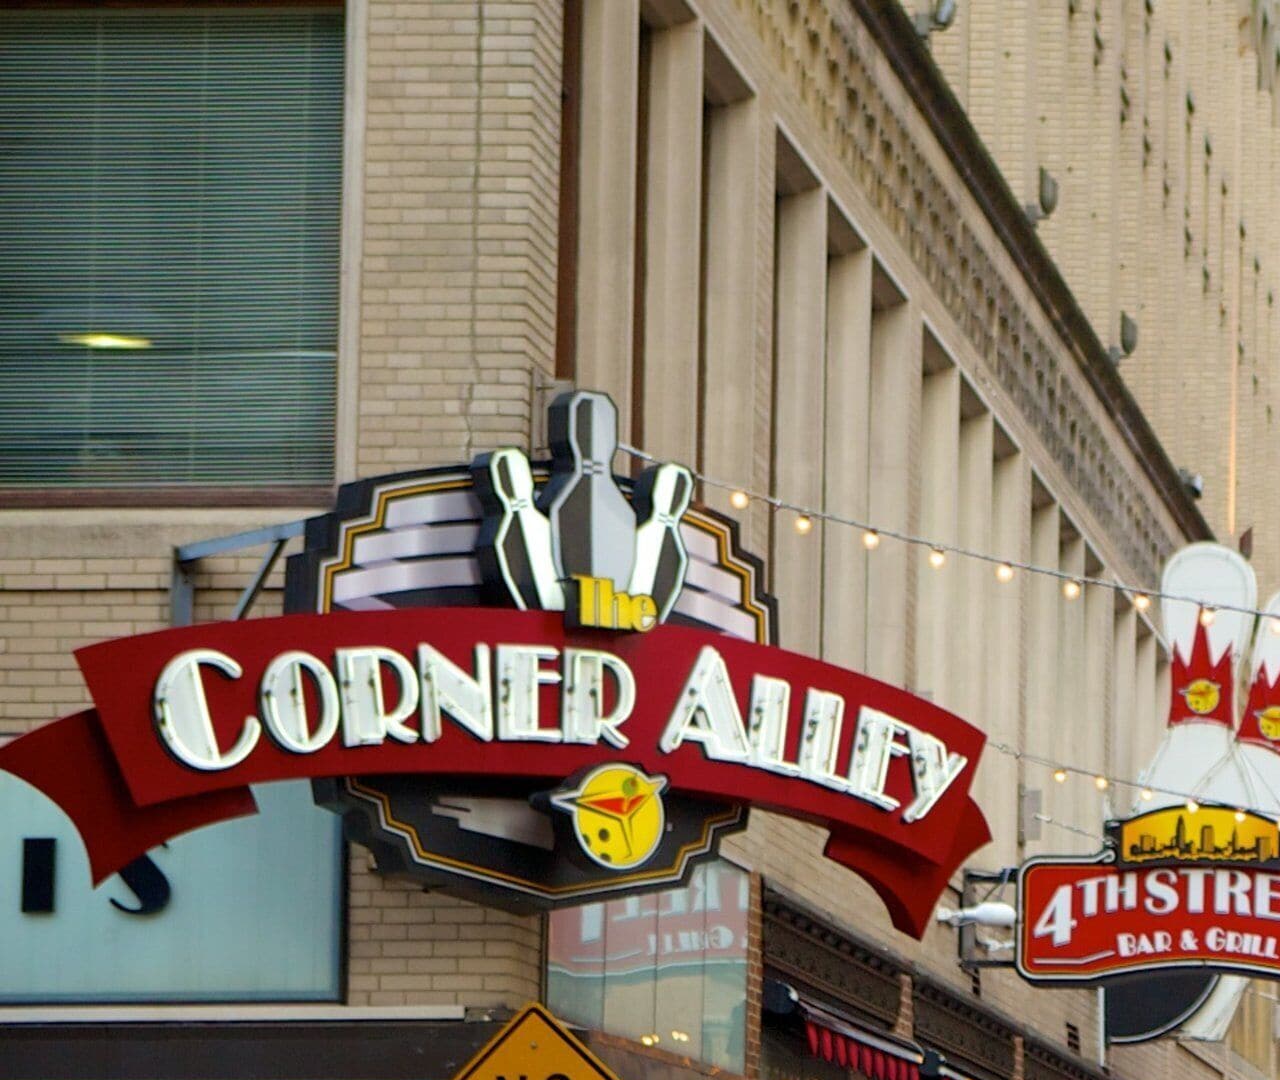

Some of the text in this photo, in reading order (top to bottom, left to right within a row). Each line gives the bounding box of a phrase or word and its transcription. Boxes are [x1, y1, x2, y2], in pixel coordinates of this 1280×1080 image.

[571, 573, 657, 633] The
[153, 643, 968, 823] CORNER ALLEY
[1033, 871, 1139, 948] 4TH
[1117, 926, 1280, 960] BAR & GRILL
